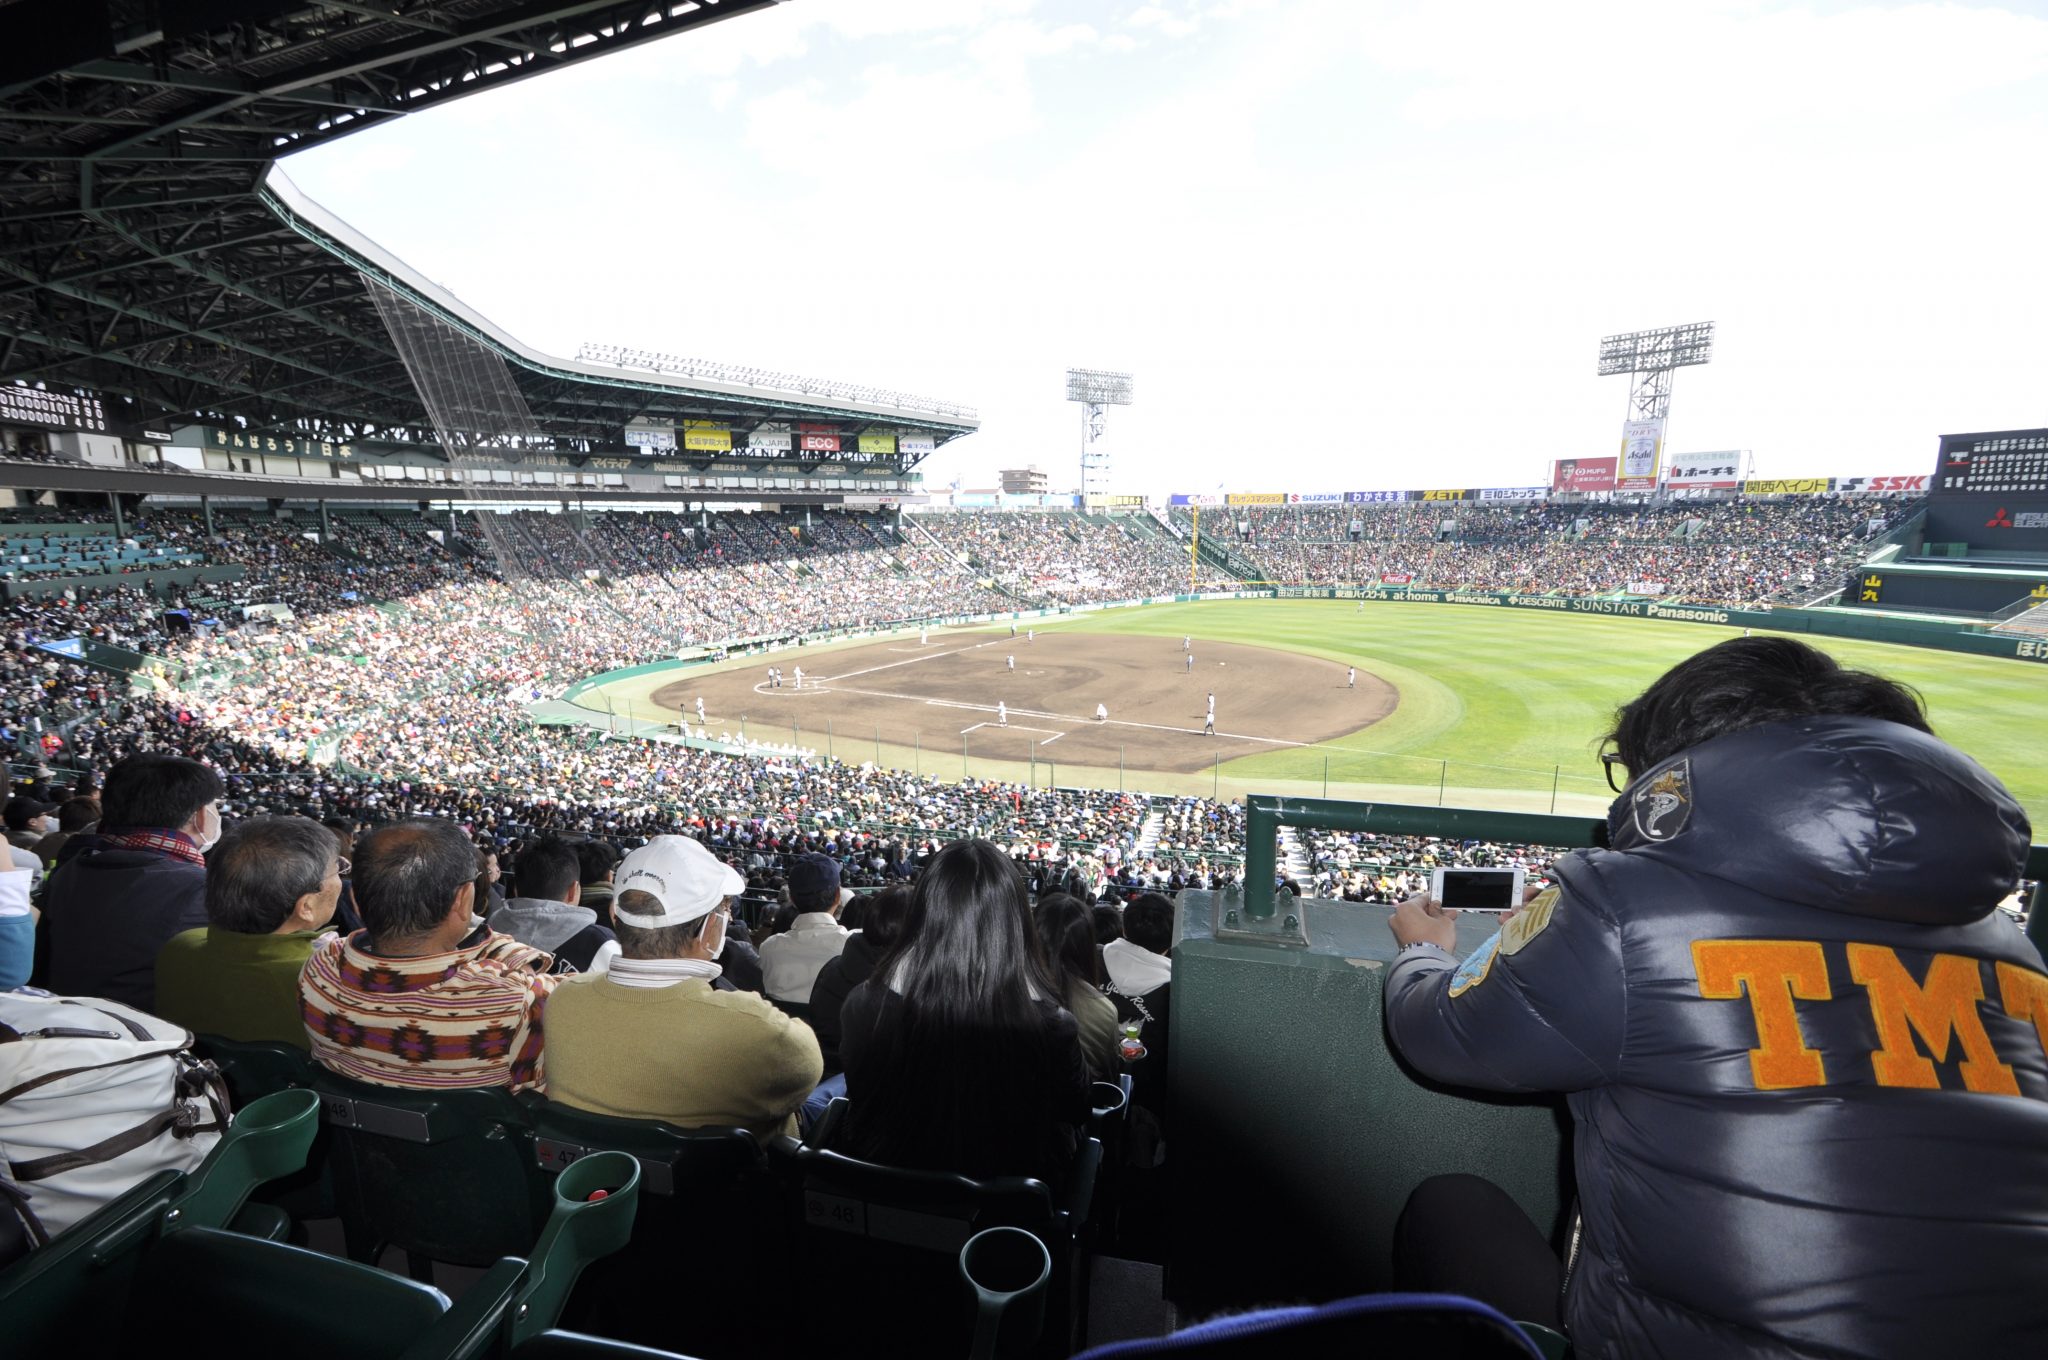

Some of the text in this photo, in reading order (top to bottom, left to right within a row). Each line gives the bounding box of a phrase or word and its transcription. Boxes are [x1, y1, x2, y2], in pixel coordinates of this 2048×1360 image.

[636, 432, 674, 447] エスカーサ
[807, 437, 834, 449] ECC
[1628, 449, 1652, 459] Asahi
[590, 457, 631, 469] マイティア
[1684, 466, 1737, 477] ホーチキ
[1746, 480, 1826, 493] 関西ペイント
[1868, 476, 1927, 491] SSK
[1302, 494, 1342, 502] SUZUKI
[1353, 491, 1407, 502] わかさ生活
[1423, 490, 1465, 500] ZETT
[1484, 490, 1542, 499] 三和シャッター
[1278, 589, 1329, 598] 田辺三菱製薬
[1335, 589, 1387, 599] 東進ハイスクール
[1518, 597, 1566, 609] DESCENTE
[1573, 600, 1640, 615] SUNSTAR
[1647, 604, 1729, 623] Panasonic
[1130, 995, 1155, 1022] Resort
[331, 1102, 348, 1118] 48
[557, 1150, 576, 1165] 47
